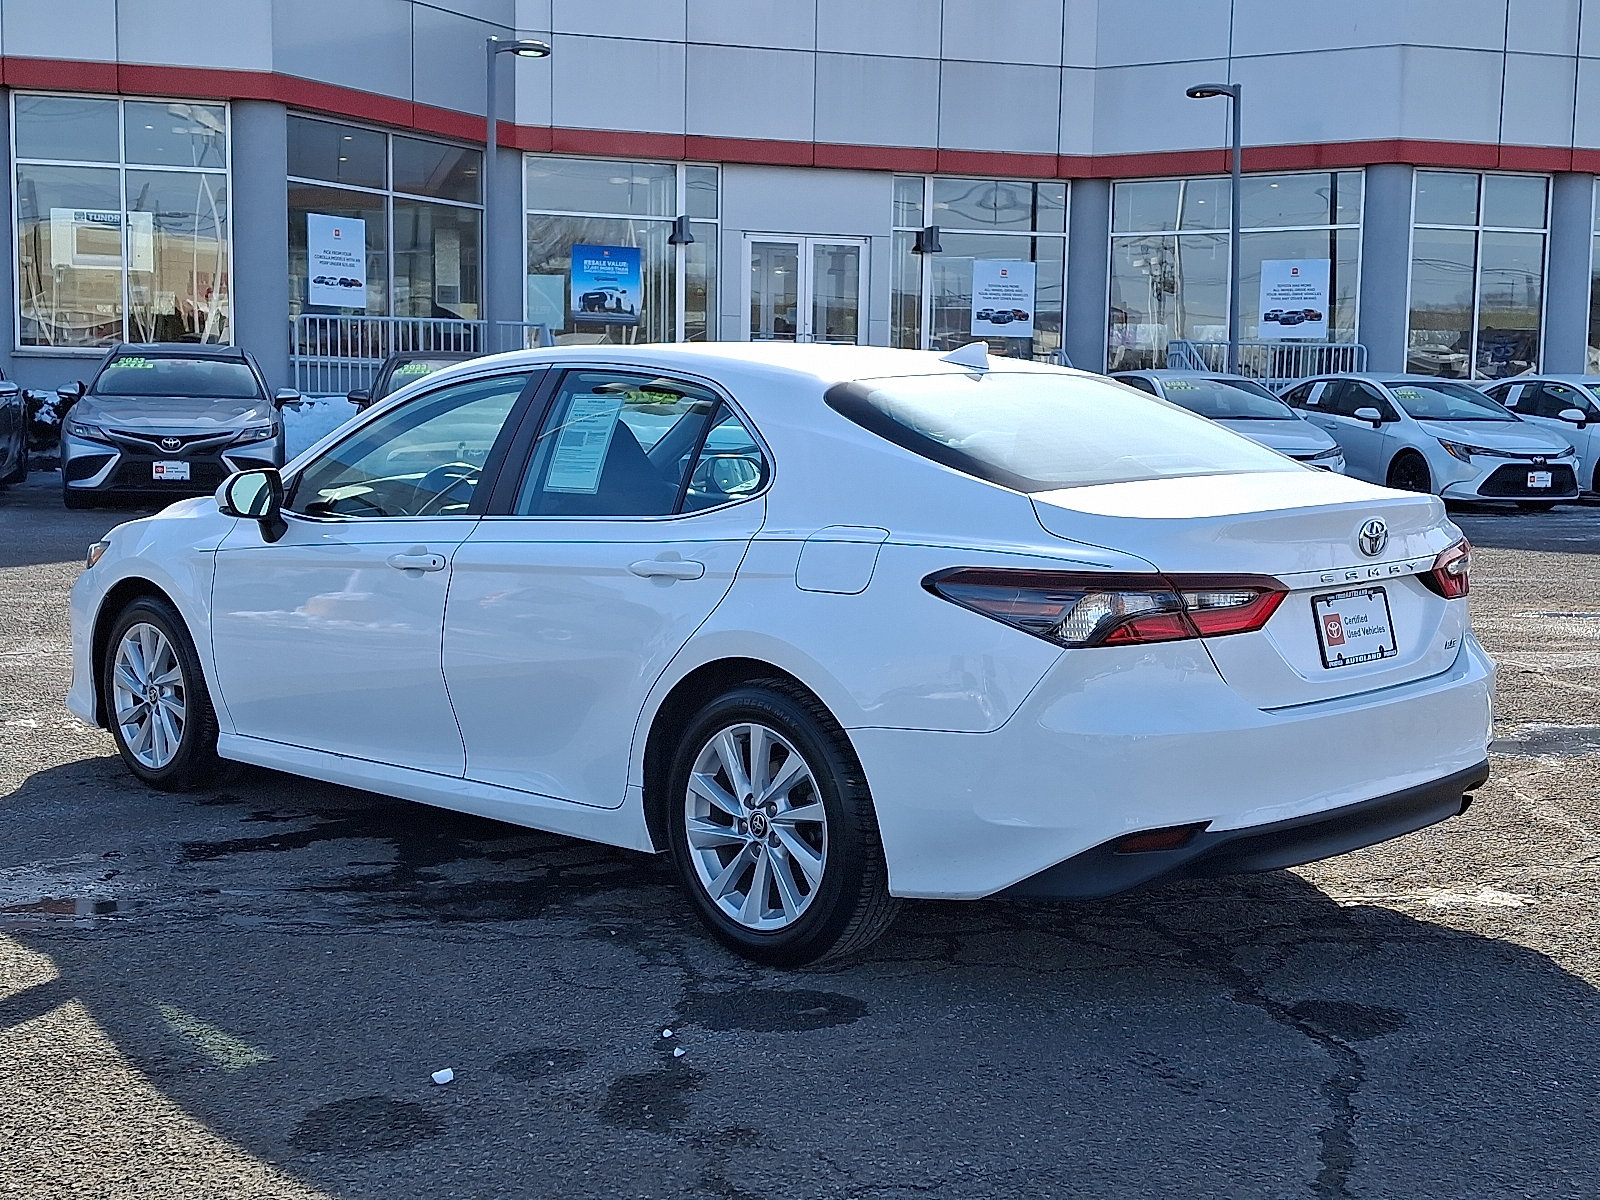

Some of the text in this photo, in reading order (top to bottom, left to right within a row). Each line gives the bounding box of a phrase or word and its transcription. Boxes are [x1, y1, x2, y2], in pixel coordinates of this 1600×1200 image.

[87, 213, 121, 223] TUNDR
[1320, 561, 1417, 584] CAMRY
[1343, 613, 1368, 626] Certified
[1346, 624, 1386, 639] Used Vehicles
[1345, 652, 1382, 665] AUTOLAND
